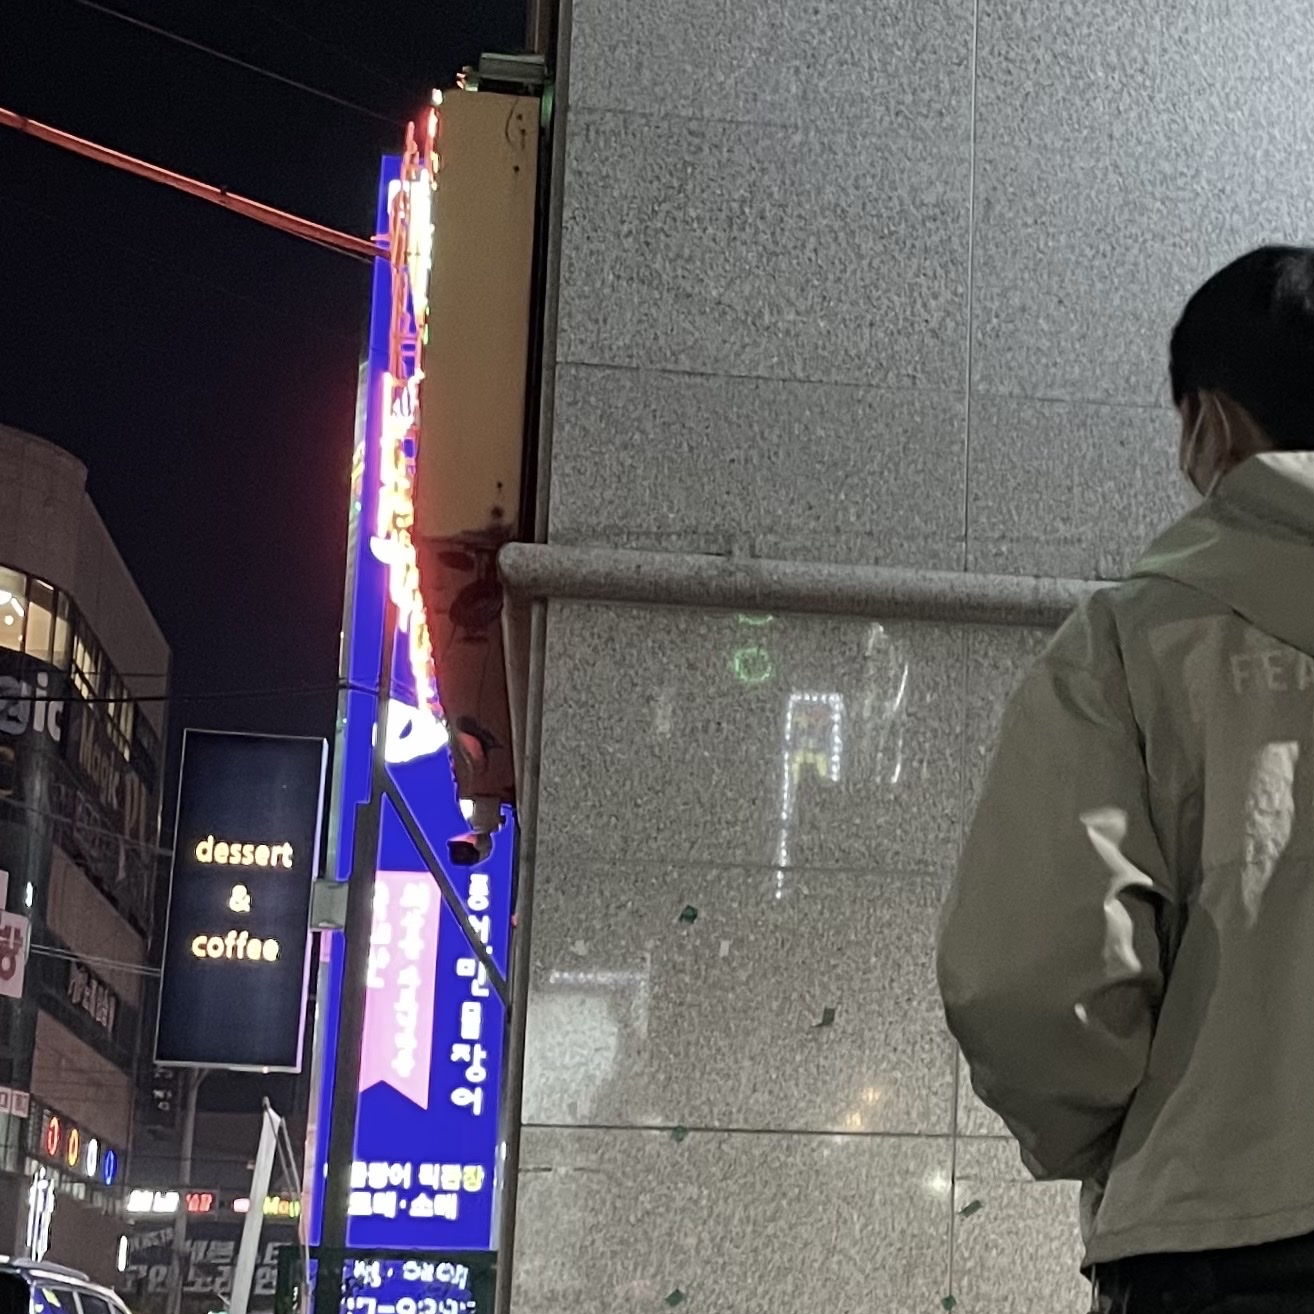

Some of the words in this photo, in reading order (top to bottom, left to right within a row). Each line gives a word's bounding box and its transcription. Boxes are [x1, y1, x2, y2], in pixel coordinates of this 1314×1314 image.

[195, 835, 293, 868] dessert
[229, 885, 251, 912] &
[192, 930, 279, 961] coffee
